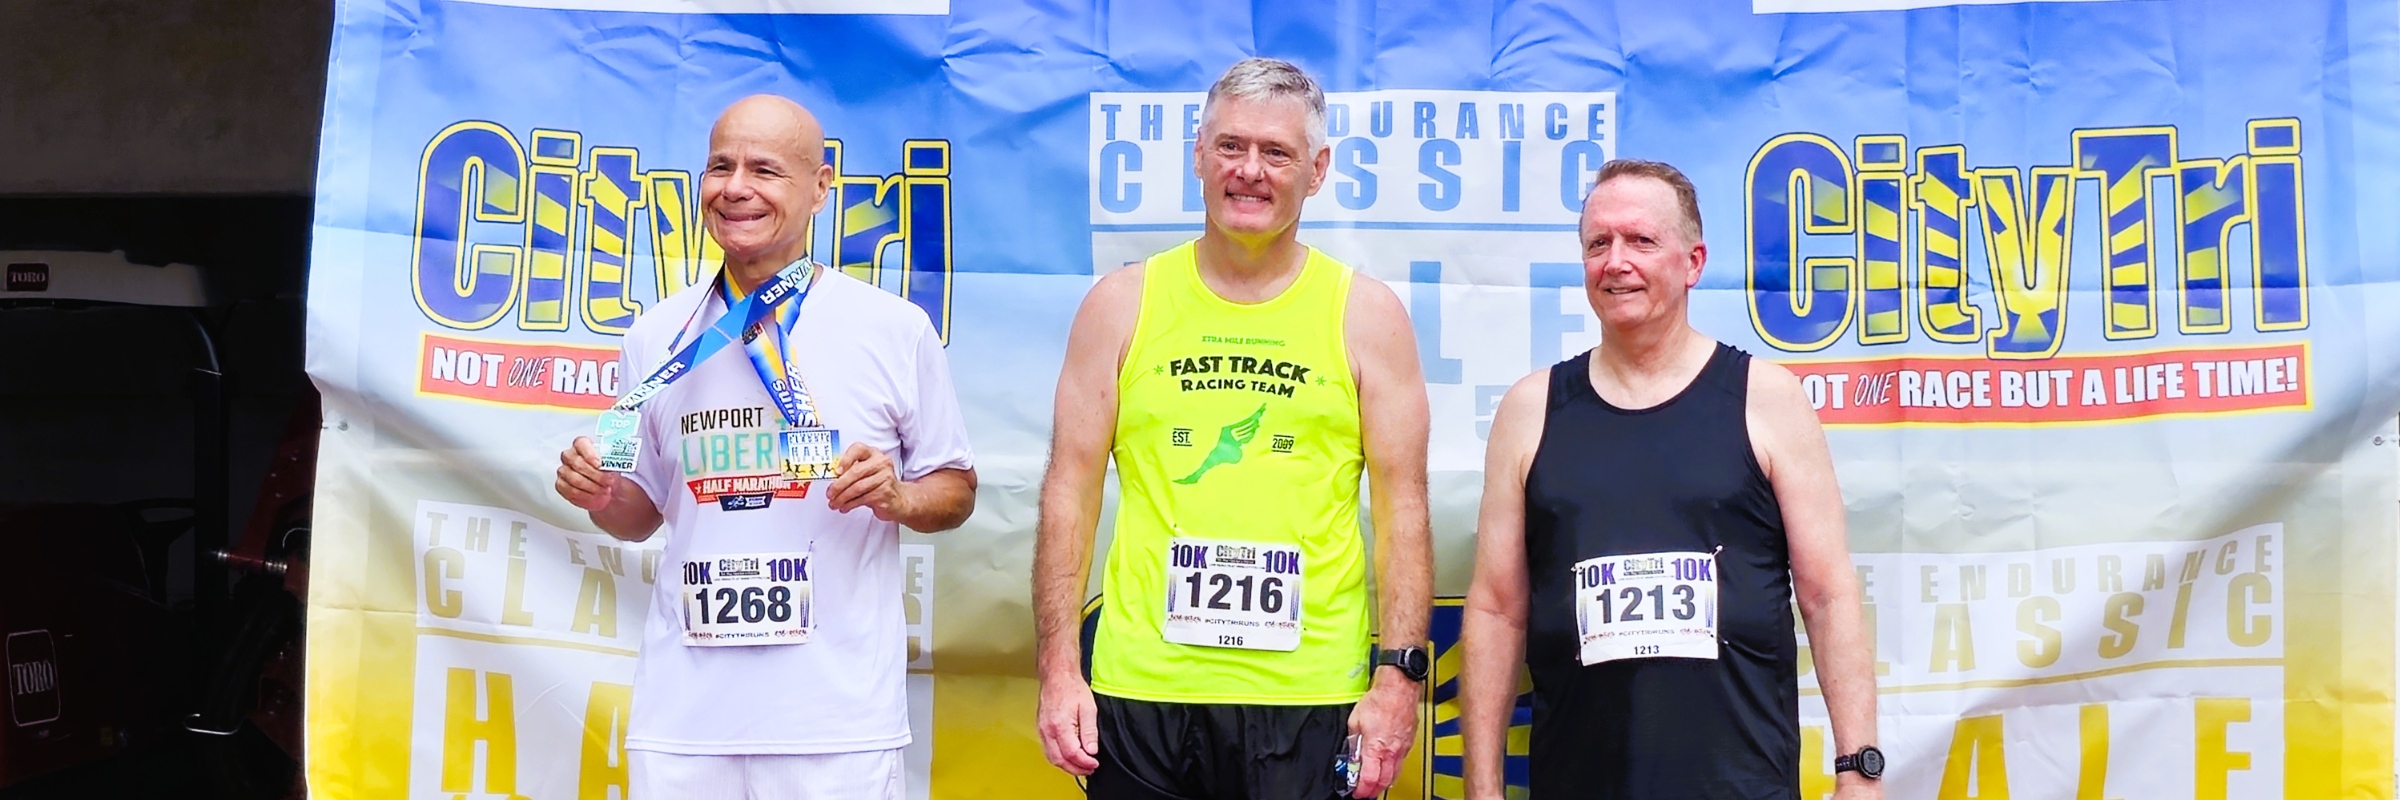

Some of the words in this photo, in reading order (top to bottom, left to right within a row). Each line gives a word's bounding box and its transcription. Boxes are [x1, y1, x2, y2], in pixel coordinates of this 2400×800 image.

[1328, 101, 1604, 141] DURANCE
[1745, 117, 2309, 359] CityTri
[12, 272, 46, 282] TORO
[1225, 336, 1243, 344] MILE
[1245, 338, 1286, 347] RUNNING
[431, 347, 505, 387] NOT
[507, 357, 551, 388] ONE
[552, 357, 620, 397] RAC
[1170, 356, 1223, 376] FAST
[1228, 356, 1311, 384] TRACK
[1797, 373, 1849, 410] OT
[1854, 371, 1897, 406] ONE
[1899, 370, 1992, 409] RACE
[2000, 369, 2073, 408] BUT
[2081, 368, 2107, 406] A
[2114, 362, 2186, 404] LIFE
[2191, 356, 2298, 398] TIME!
[1181, 379, 1246, 392] RACING
[1250, 380, 1295, 398] TEAM
[610, 418, 631, 429] TOP
[681, 407, 764, 436] NEWPORT
[791, 445, 830, 457] HALF
[1172, 431, 1191, 443] EST.
[1272, 438, 1294, 450] 2009
[682, 433, 774, 476] LIBER
[702, 479, 732, 494] HALF
[733, 476, 791, 493] MARATHON
[427, 511, 528, 558] THE
[683, 561, 713, 585] 10K
[719, 558, 759, 572] CityTri
[766, 558, 808, 582] 10K
[1171, 544, 1208, 569] 10K
[1216, 545, 1256, 559] CityTri
[1263, 550, 1300, 575] 10K
[1578, 562, 1616, 590] 10K
[1623, 557, 1664, 571] CityTri
[1671, 557, 1712, 582] 10K
[1921, 535, 2272, 602] ENDURANCE
[695, 586, 792, 624] 1268
[1186, 571, 1283, 613] 1216
[1596, 585, 1696, 624] 1213
[1218, 635, 1244, 646] 1216
[1634, 645, 1660, 655] 1213
[12, 660, 54, 695] TORO
